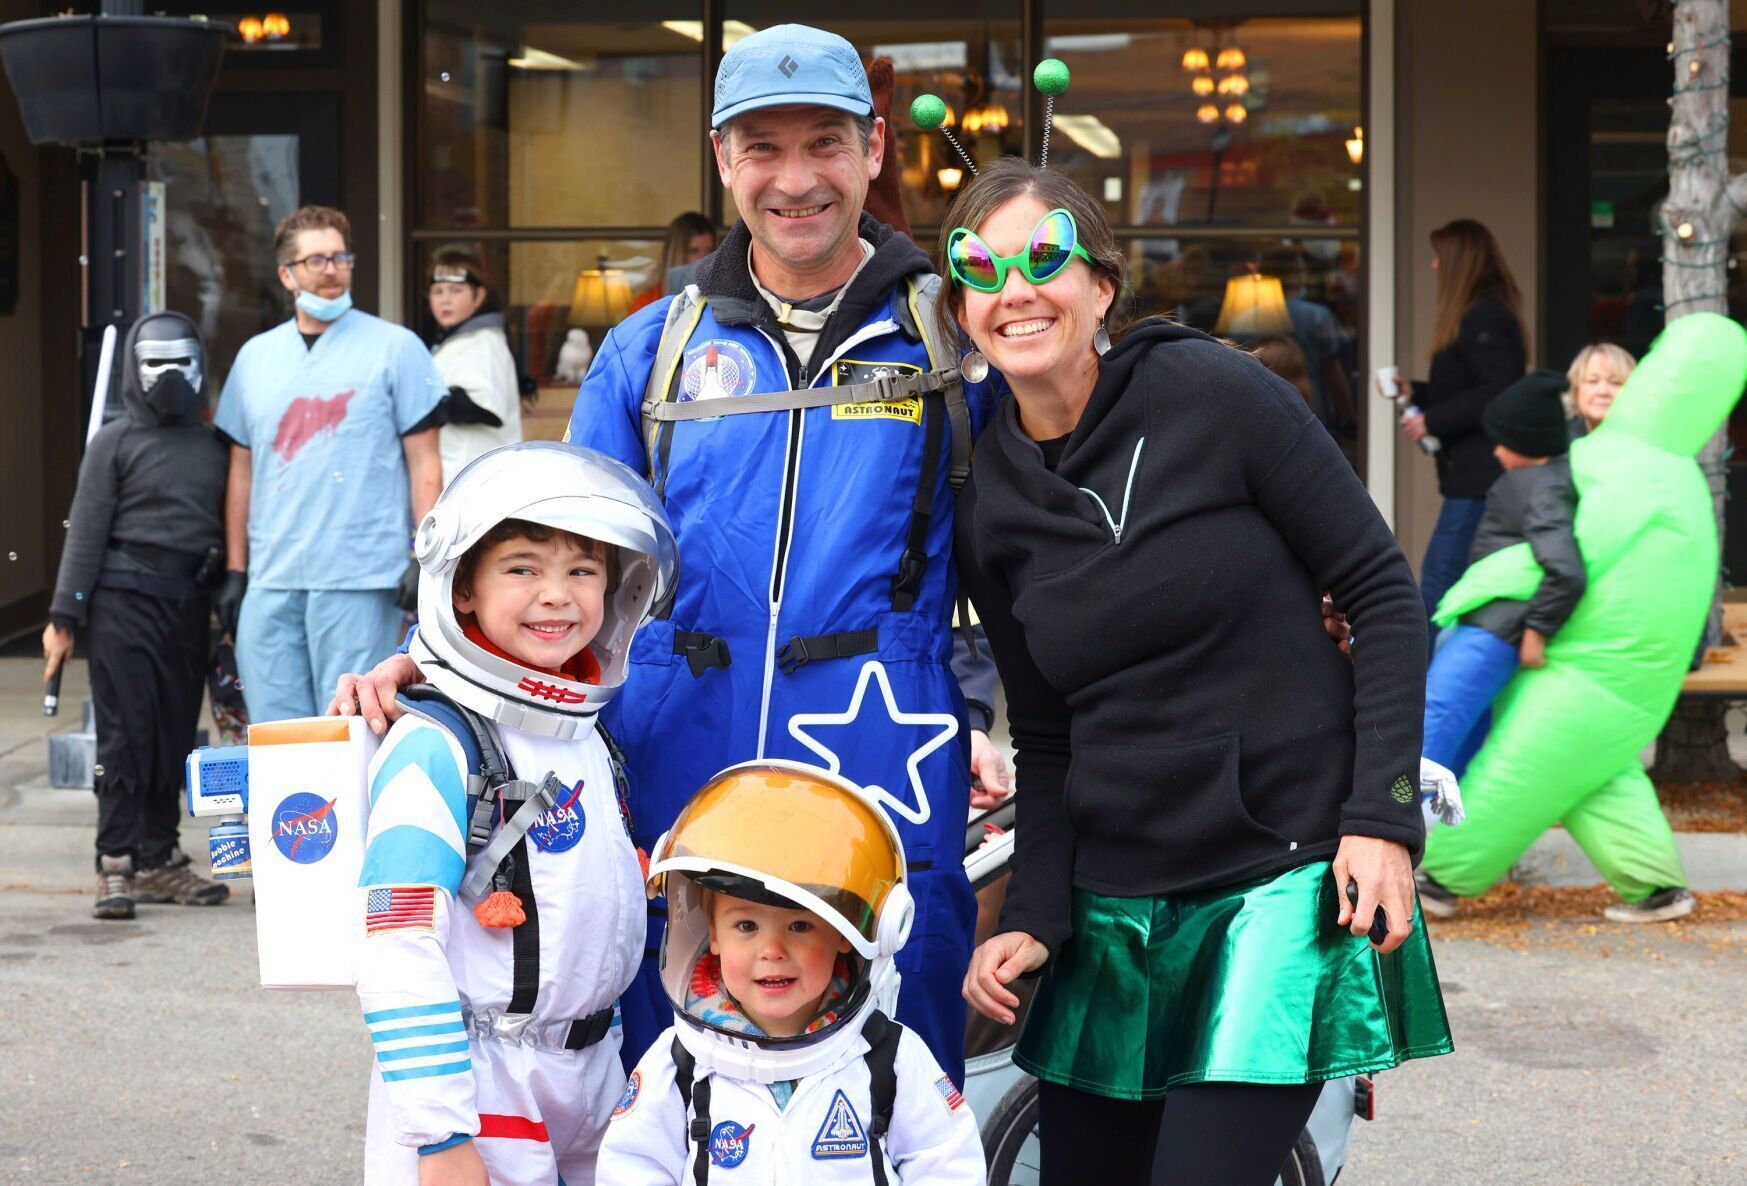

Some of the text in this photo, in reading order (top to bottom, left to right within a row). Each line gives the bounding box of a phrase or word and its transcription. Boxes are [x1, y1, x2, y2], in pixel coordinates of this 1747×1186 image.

[844, 406, 914, 417] ASTRONAUT
[534, 806, 579, 828] NASA
[278, 819, 332, 836] NASA
[715, 1138, 744, 1151] NASA
[816, 1143, 866, 1152] ASTRONAUT
